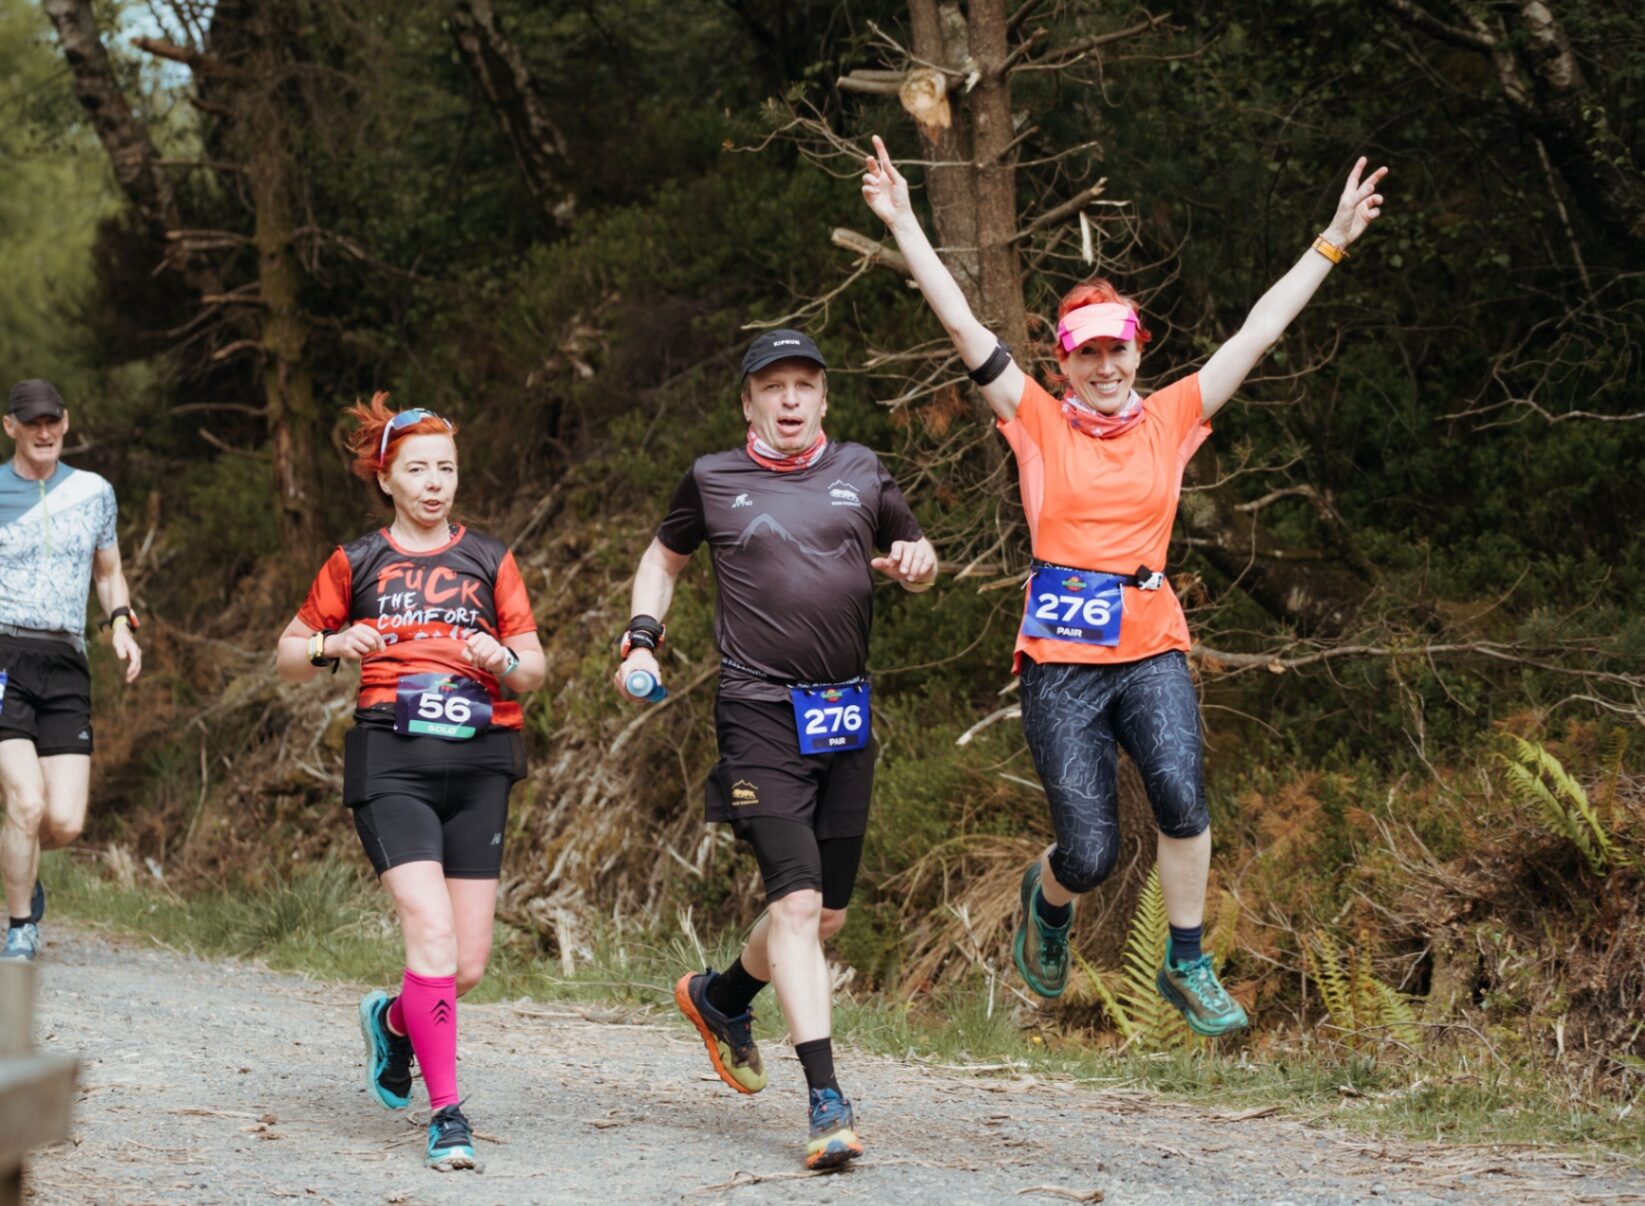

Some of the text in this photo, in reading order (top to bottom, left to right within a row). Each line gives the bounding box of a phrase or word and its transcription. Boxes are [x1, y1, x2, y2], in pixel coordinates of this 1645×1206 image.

[377, 592, 418, 613] THE
[1035, 593, 1111, 626] 276
[377, 607, 480, 630] COMFORT
[1057, 627, 1082, 637] PAIR
[418, 693, 471, 722] 56
[427, 724, 457, 735] SOLO
[804, 705, 862, 735] 276
[829, 737, 846, 746] PAIR
